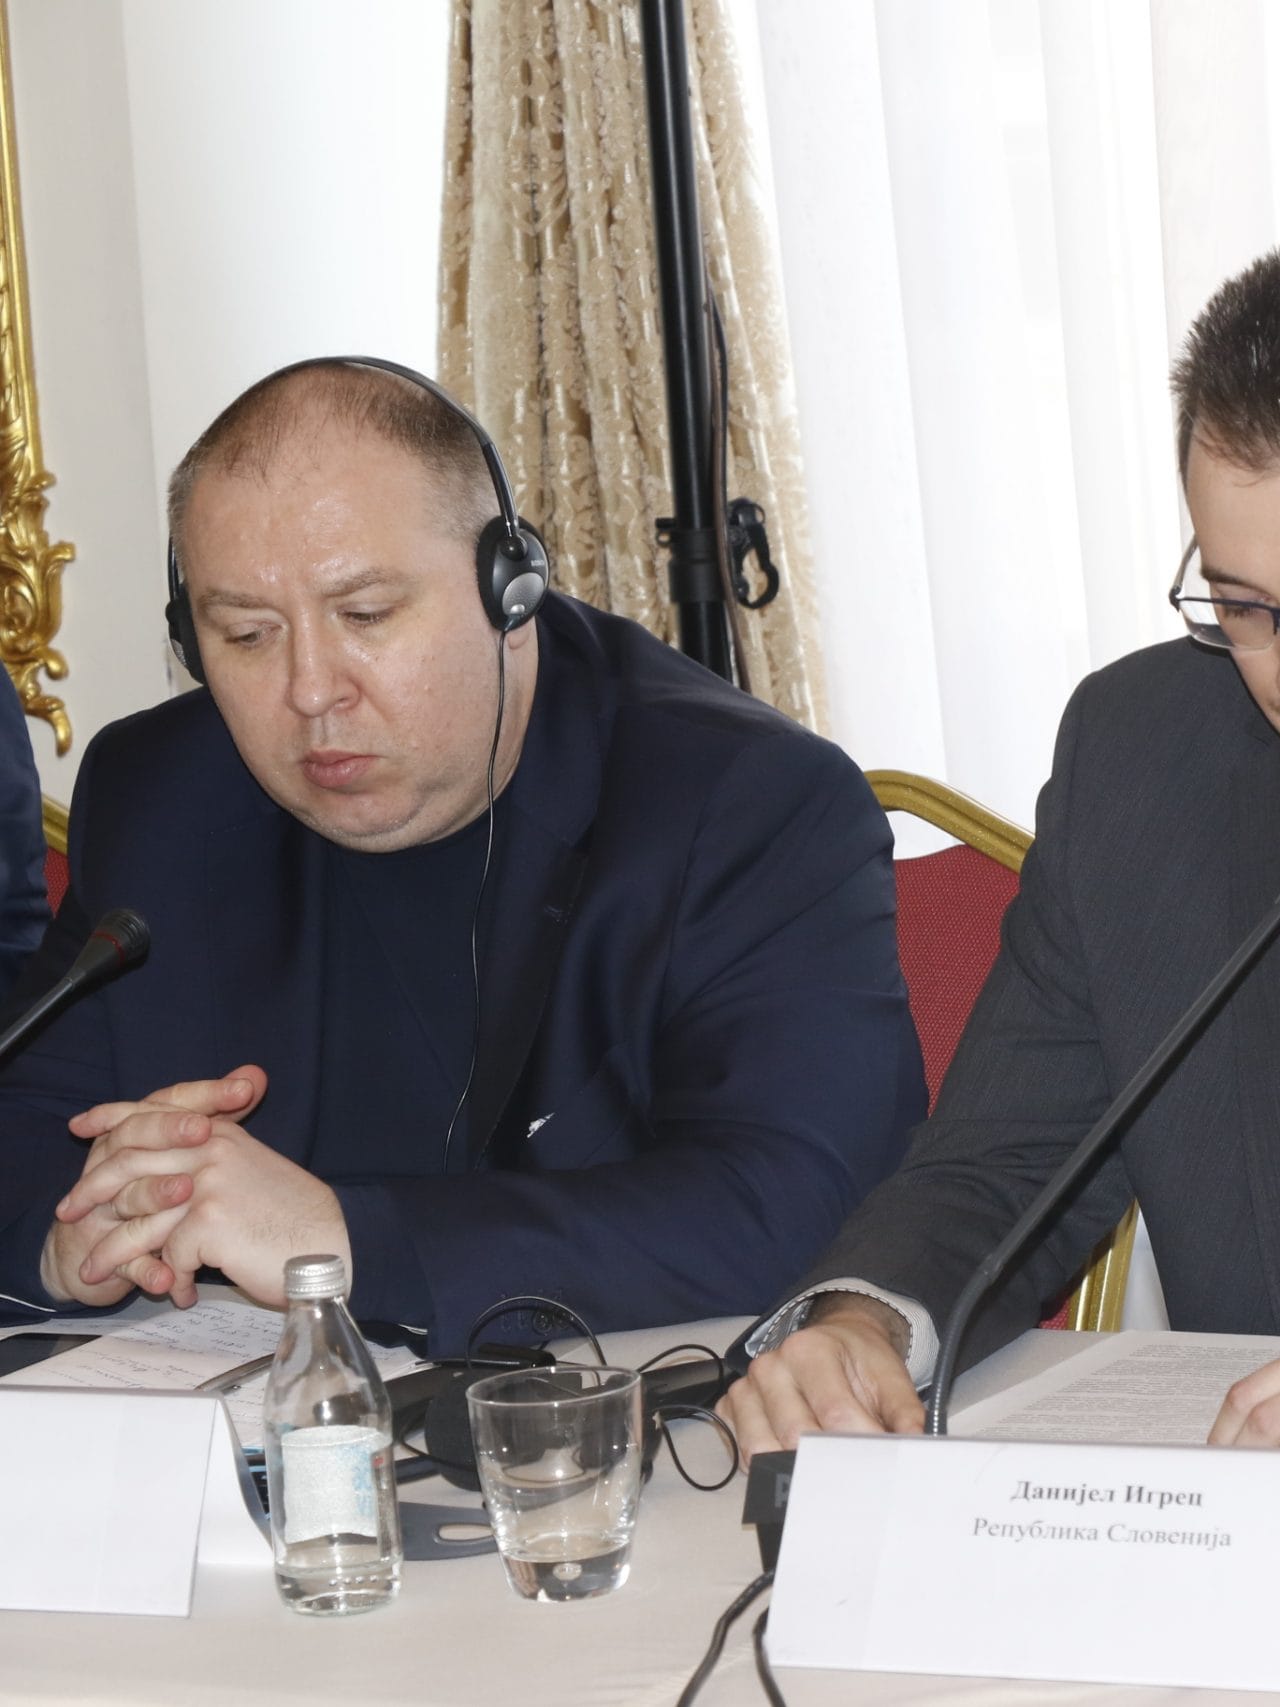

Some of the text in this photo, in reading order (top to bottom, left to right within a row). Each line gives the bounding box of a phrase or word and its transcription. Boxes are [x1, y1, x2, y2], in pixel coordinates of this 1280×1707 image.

[1010, 1480, 1115, 1506] Данијел
[973, 1517, 1232, 1551] Република Словенија
